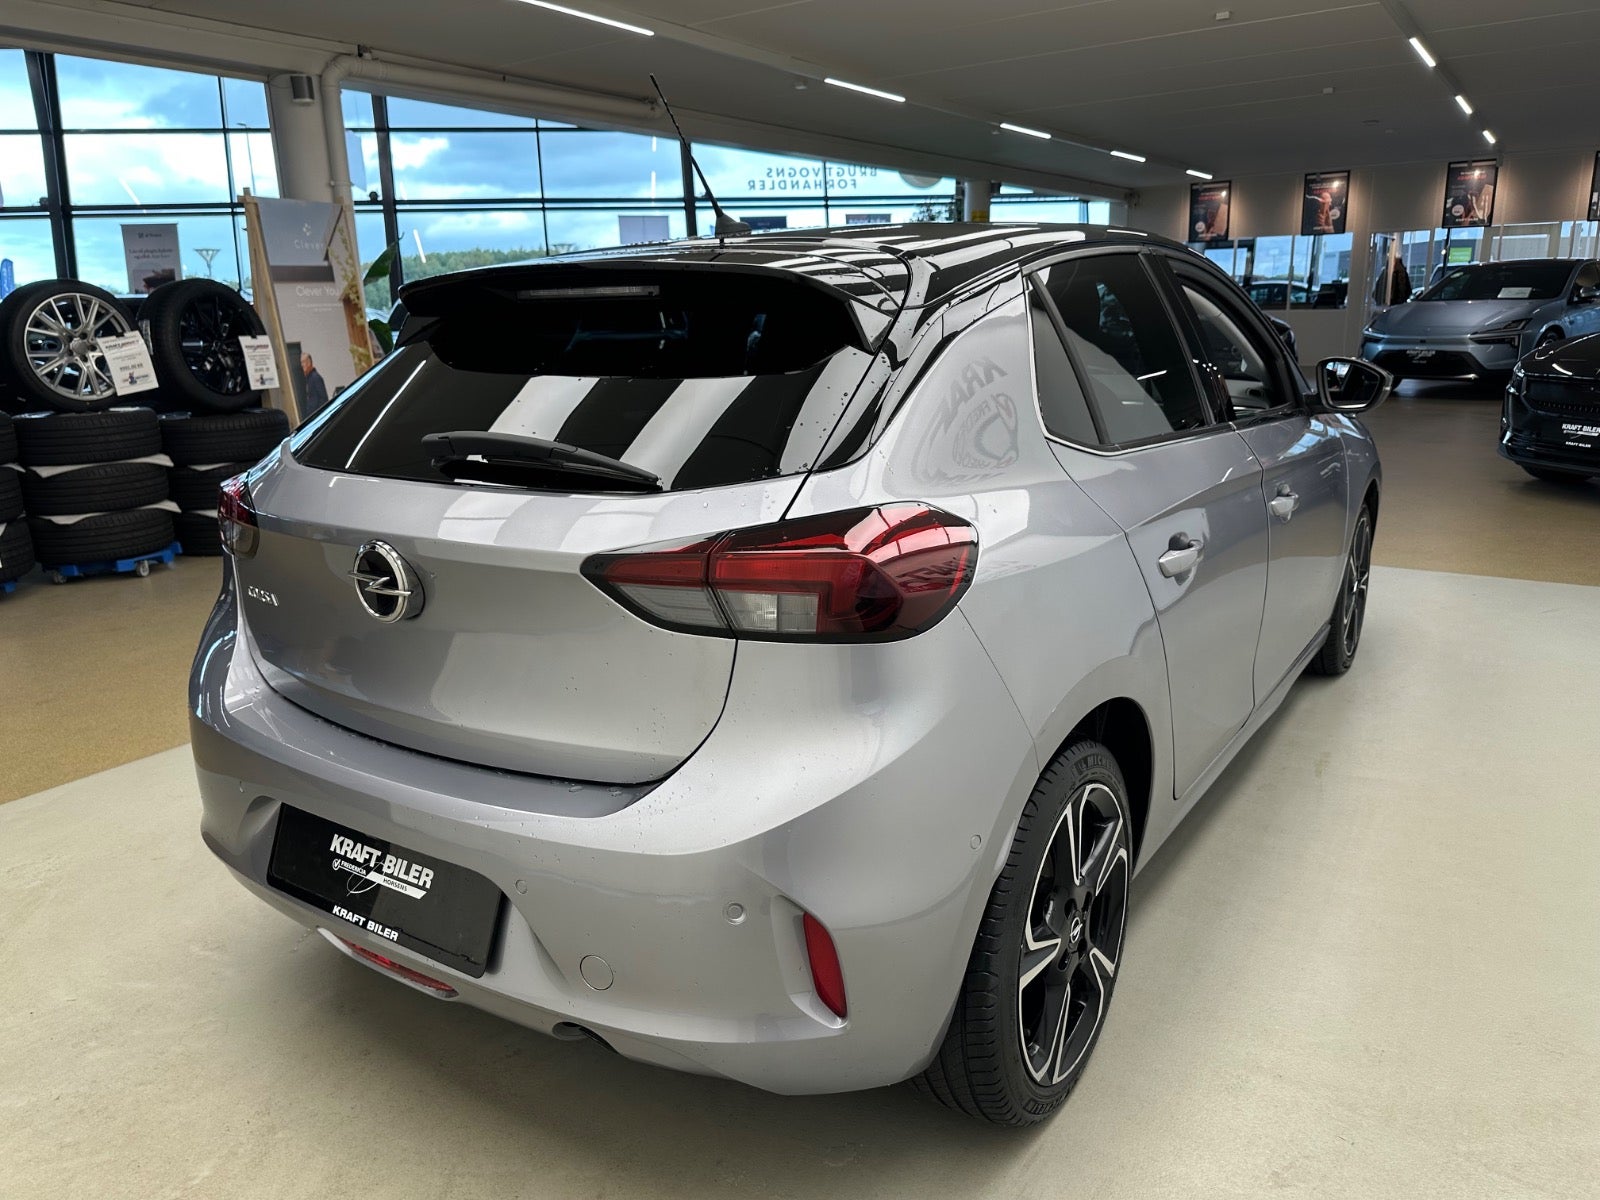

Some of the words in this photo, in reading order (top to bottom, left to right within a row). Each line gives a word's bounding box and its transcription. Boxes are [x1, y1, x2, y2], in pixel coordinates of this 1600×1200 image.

[329, 833, 381, 868] KRAFT
[382, 854, 434, 888] BILER
[383, 877, 408, 891] HORSENS
[332, 905, 366, 925] KRAFT
[367, 920, 399, 941] BILER
